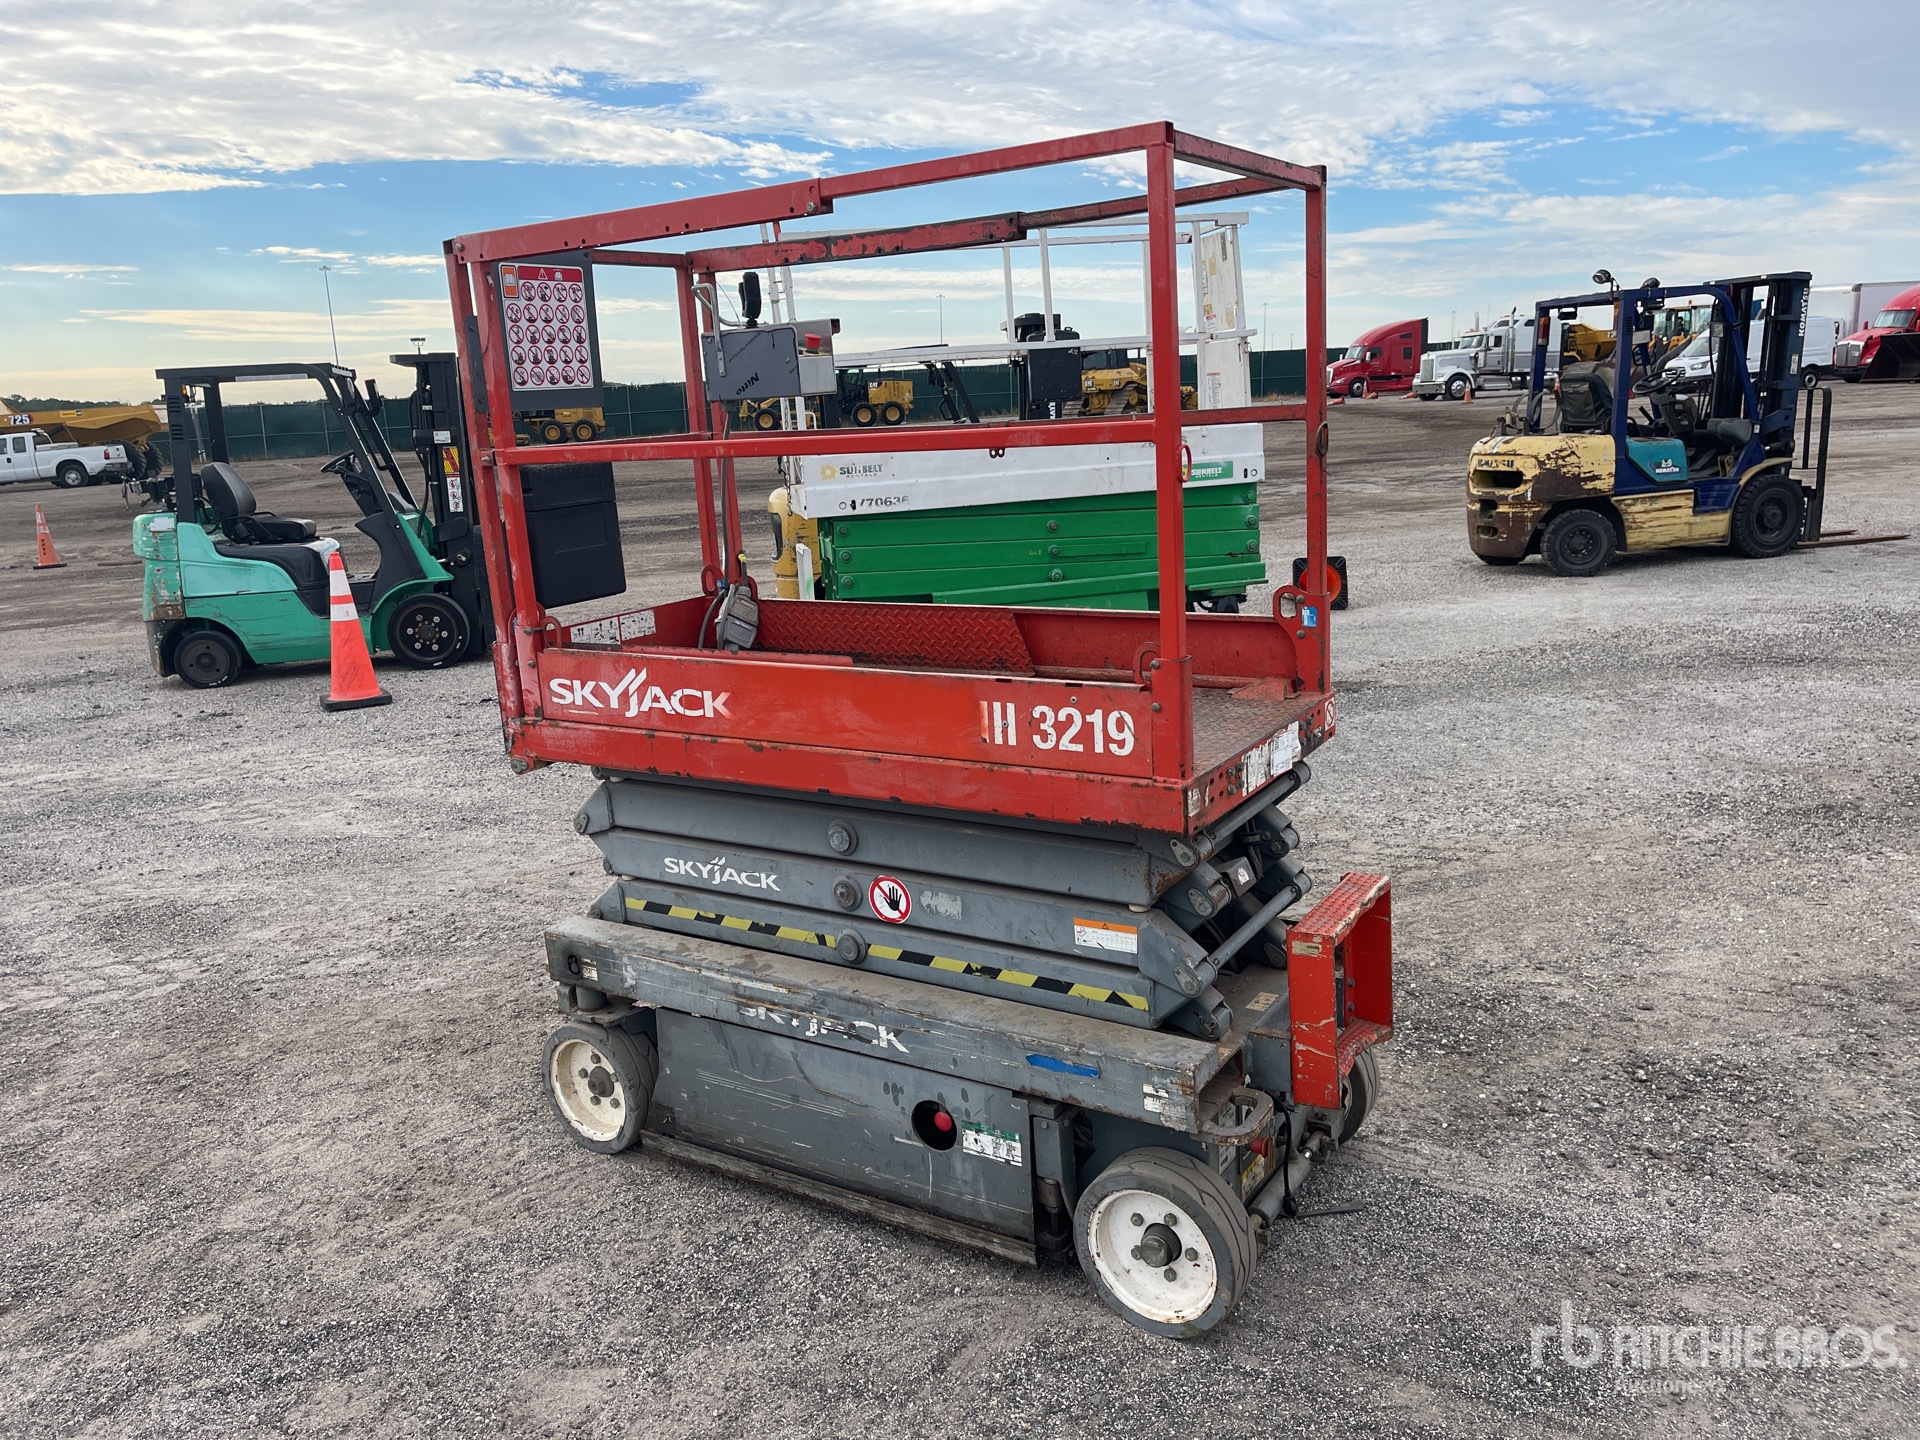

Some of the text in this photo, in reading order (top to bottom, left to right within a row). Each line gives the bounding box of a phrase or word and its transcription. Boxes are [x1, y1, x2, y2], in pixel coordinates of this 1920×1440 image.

[1798, 288, 1809, 336] KOMATSU
[736, 372, 760, 396] Nitto
[8, 414, 30, 426] 725
[1190, 467, 1223, 476] SUNBELT
[549, 667, 735, 720] SKYJACK
[1032, 705, 1135, 757] 3219
[663, 856, 782, 892] SKYJACK
